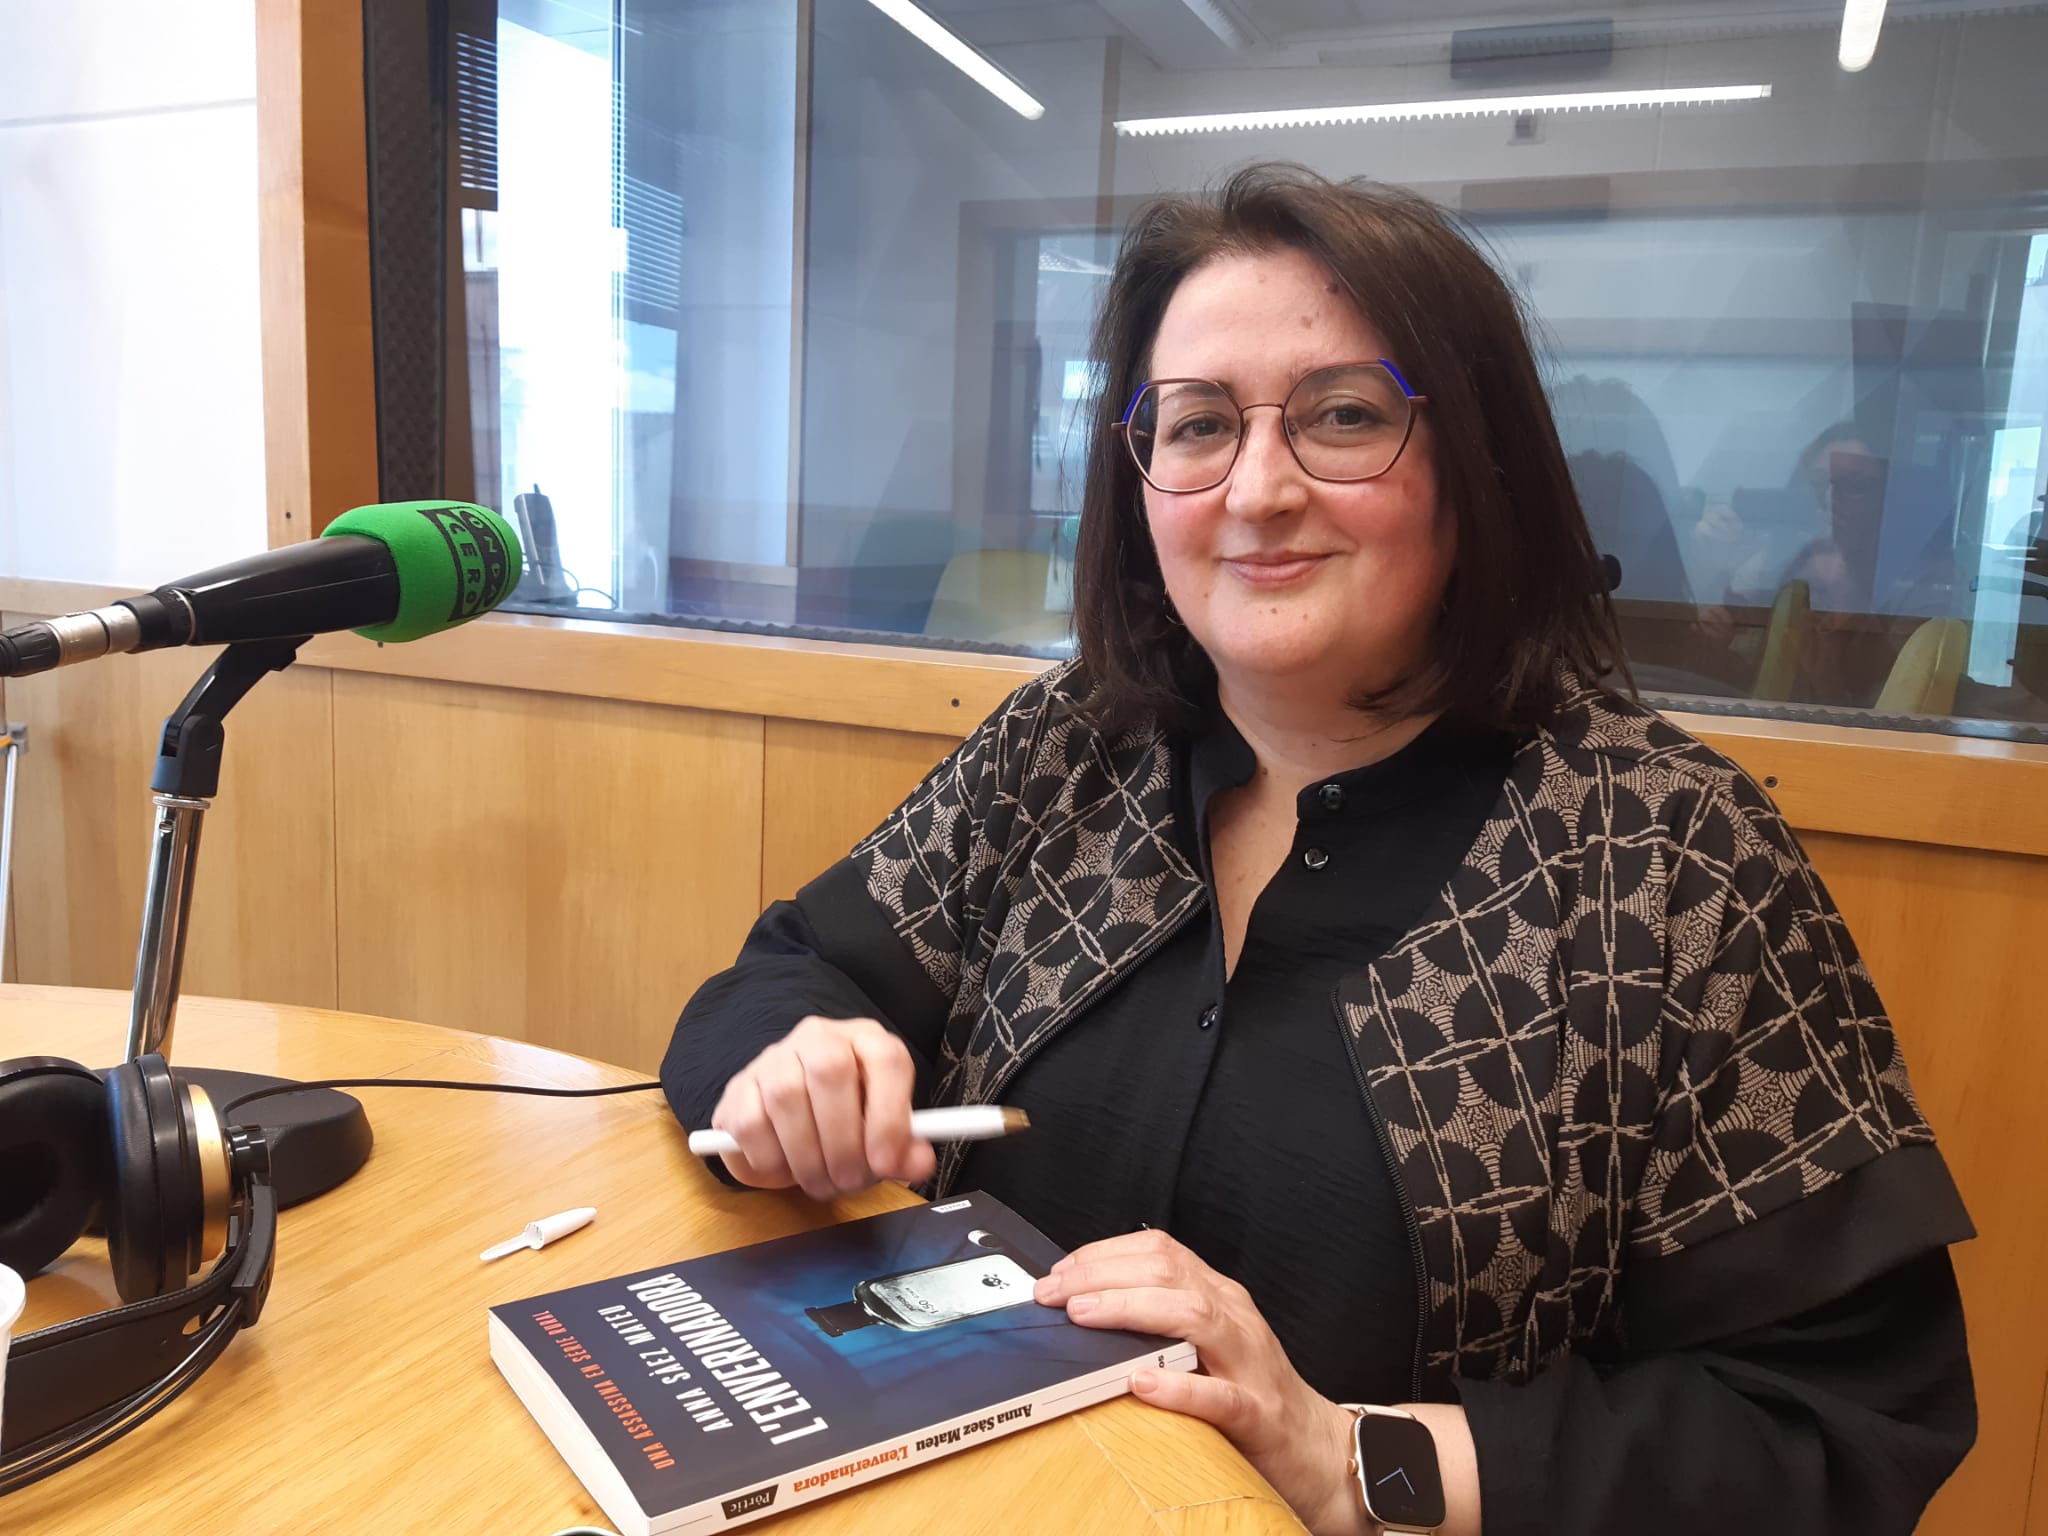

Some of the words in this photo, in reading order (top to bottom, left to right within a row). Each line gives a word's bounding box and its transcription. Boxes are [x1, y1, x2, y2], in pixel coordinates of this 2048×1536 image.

[448, 521, 482, 606] CERO
[532, 1310, 568, 1336] RURAL
[597, 1304, 656, 1346] MATEU
[555, 1335, 592, 1363] SÈRIE
[626, 1272, 829, 1445] L'ENVERINADORA
[580, 1364, 606, 1379] EN
[639, 1347, 692, 1385] SÀEZ
[594, 1379, 654, 1439] ASSASSINA
[676, 1387, 734, 1432] ANNA
[997, 1403, 1033, 1423] Anna
[962, 1413, 995, 1434] Sàez
[915, 1427, 961, 1451] Mateu
[643, 1442, 675, 1469] UNA
[792, 1445, 910, 1493] L'enverinadora
[728, 1492, 771, 1514] Pòrtic
